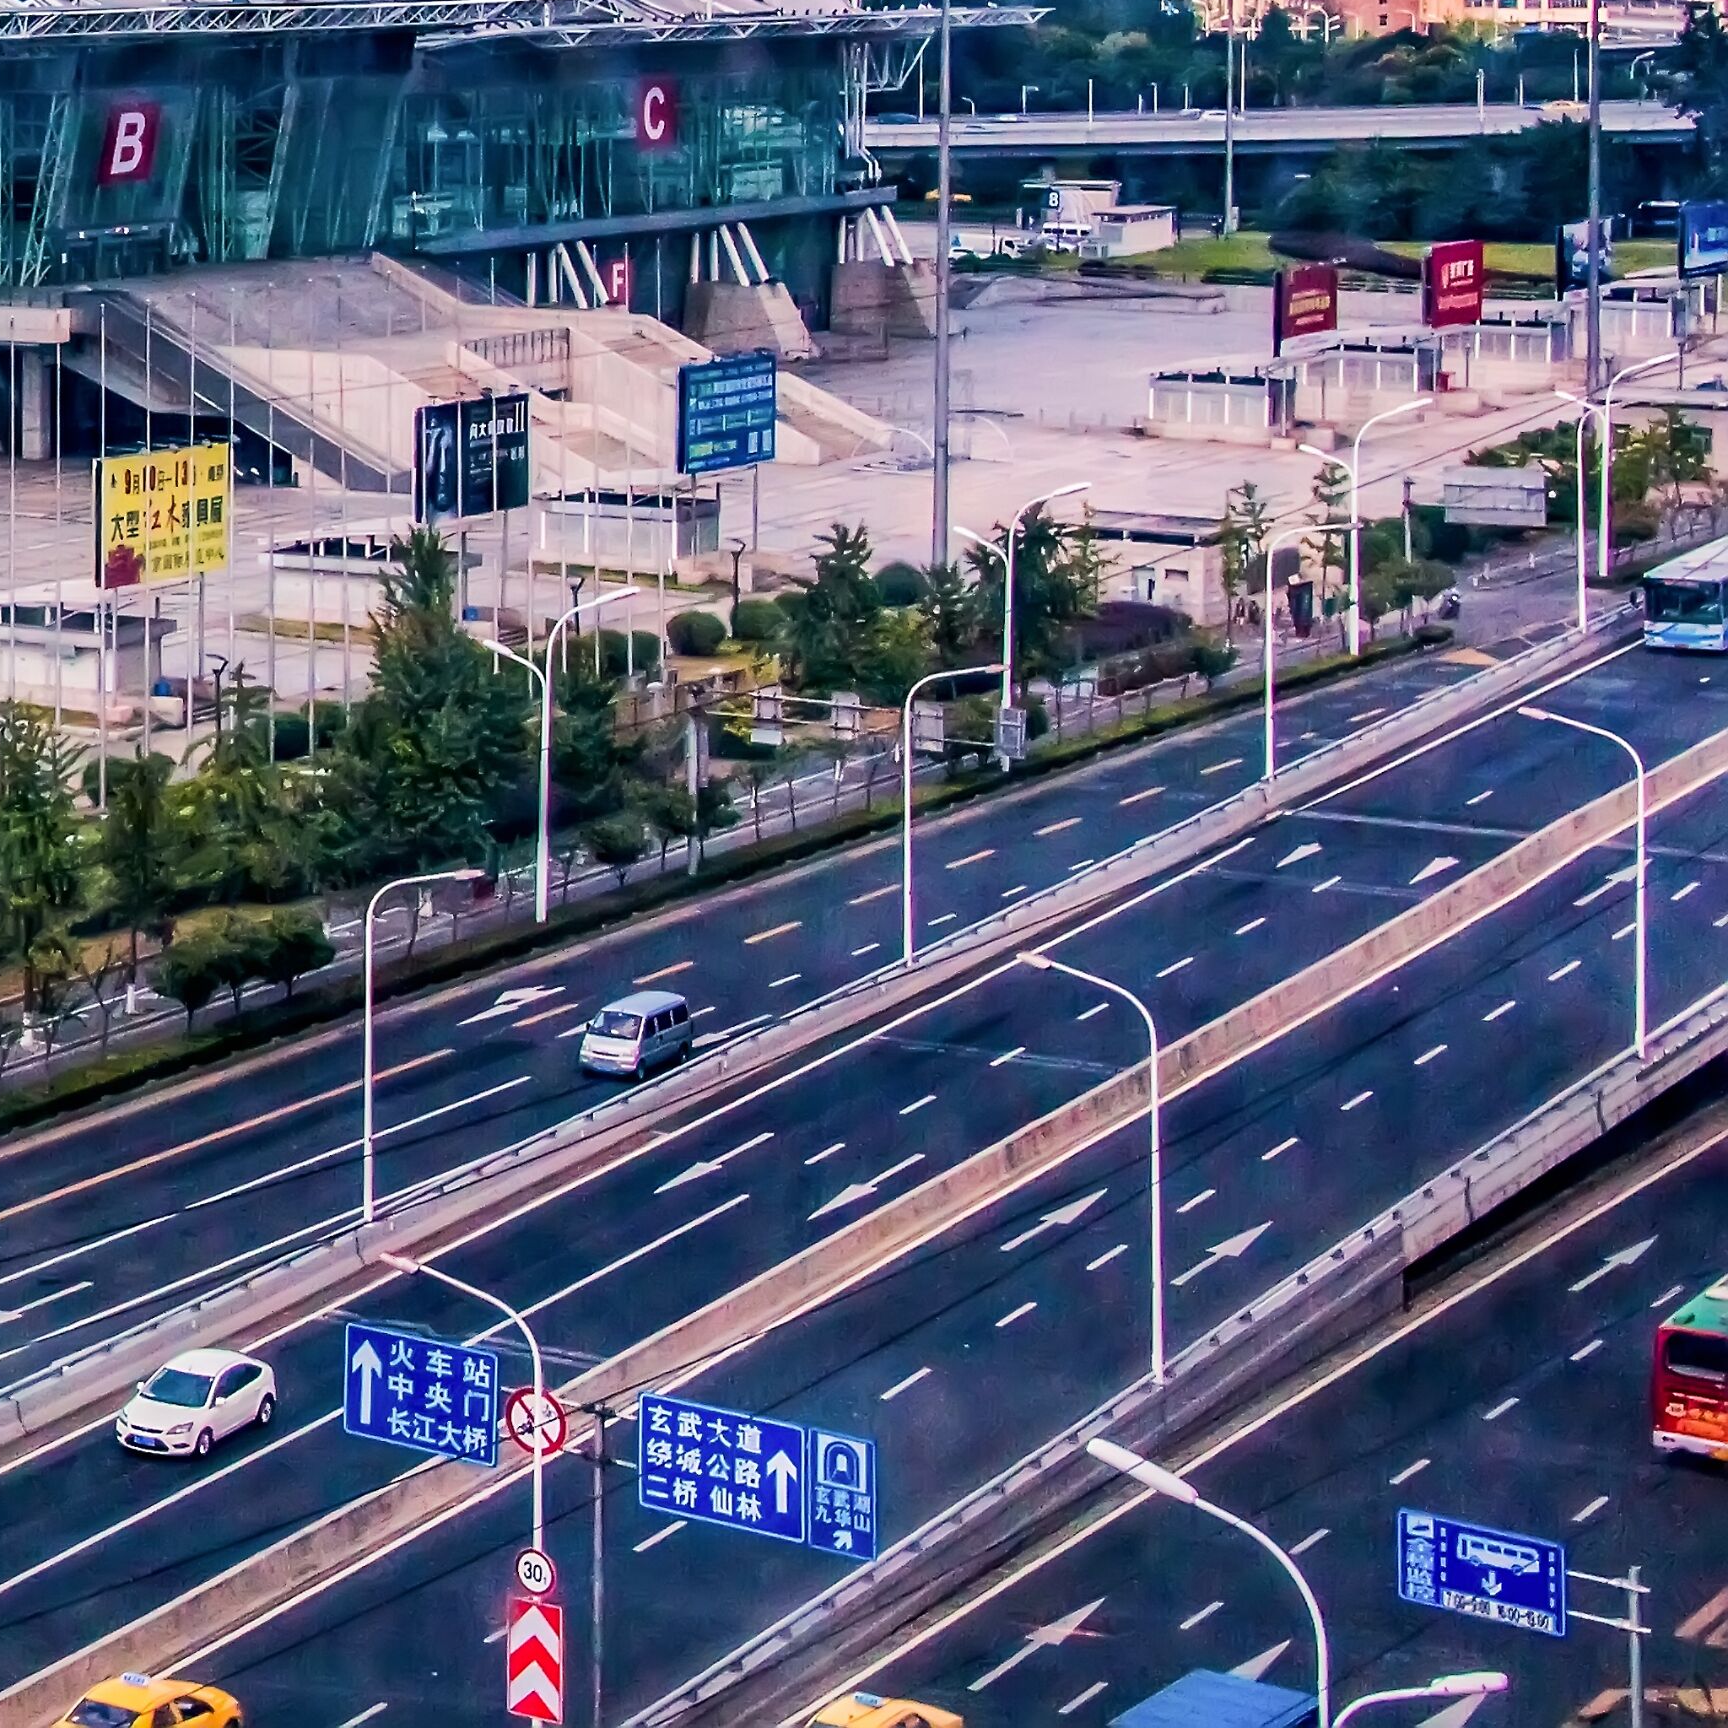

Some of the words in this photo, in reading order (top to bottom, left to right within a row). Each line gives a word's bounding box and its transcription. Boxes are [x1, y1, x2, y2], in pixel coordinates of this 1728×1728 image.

[644, 86, 665, 140] C
[110, 112, 146, 175] B
[1048, 192, 1059, 207] 8
[389, 1339, 491, 1389] 火车站
[388, 1372, 490, 1422] 中央门
[387, 1407, 488, 1457] 长江大桥
[647, 1405, 762, 1455] 玄武大道
[646, 1437, 761, 1489] 绕城公路
[646, 1474, 698, 1509] 二桥
[709, 1485, 762, 1522] 仙林
